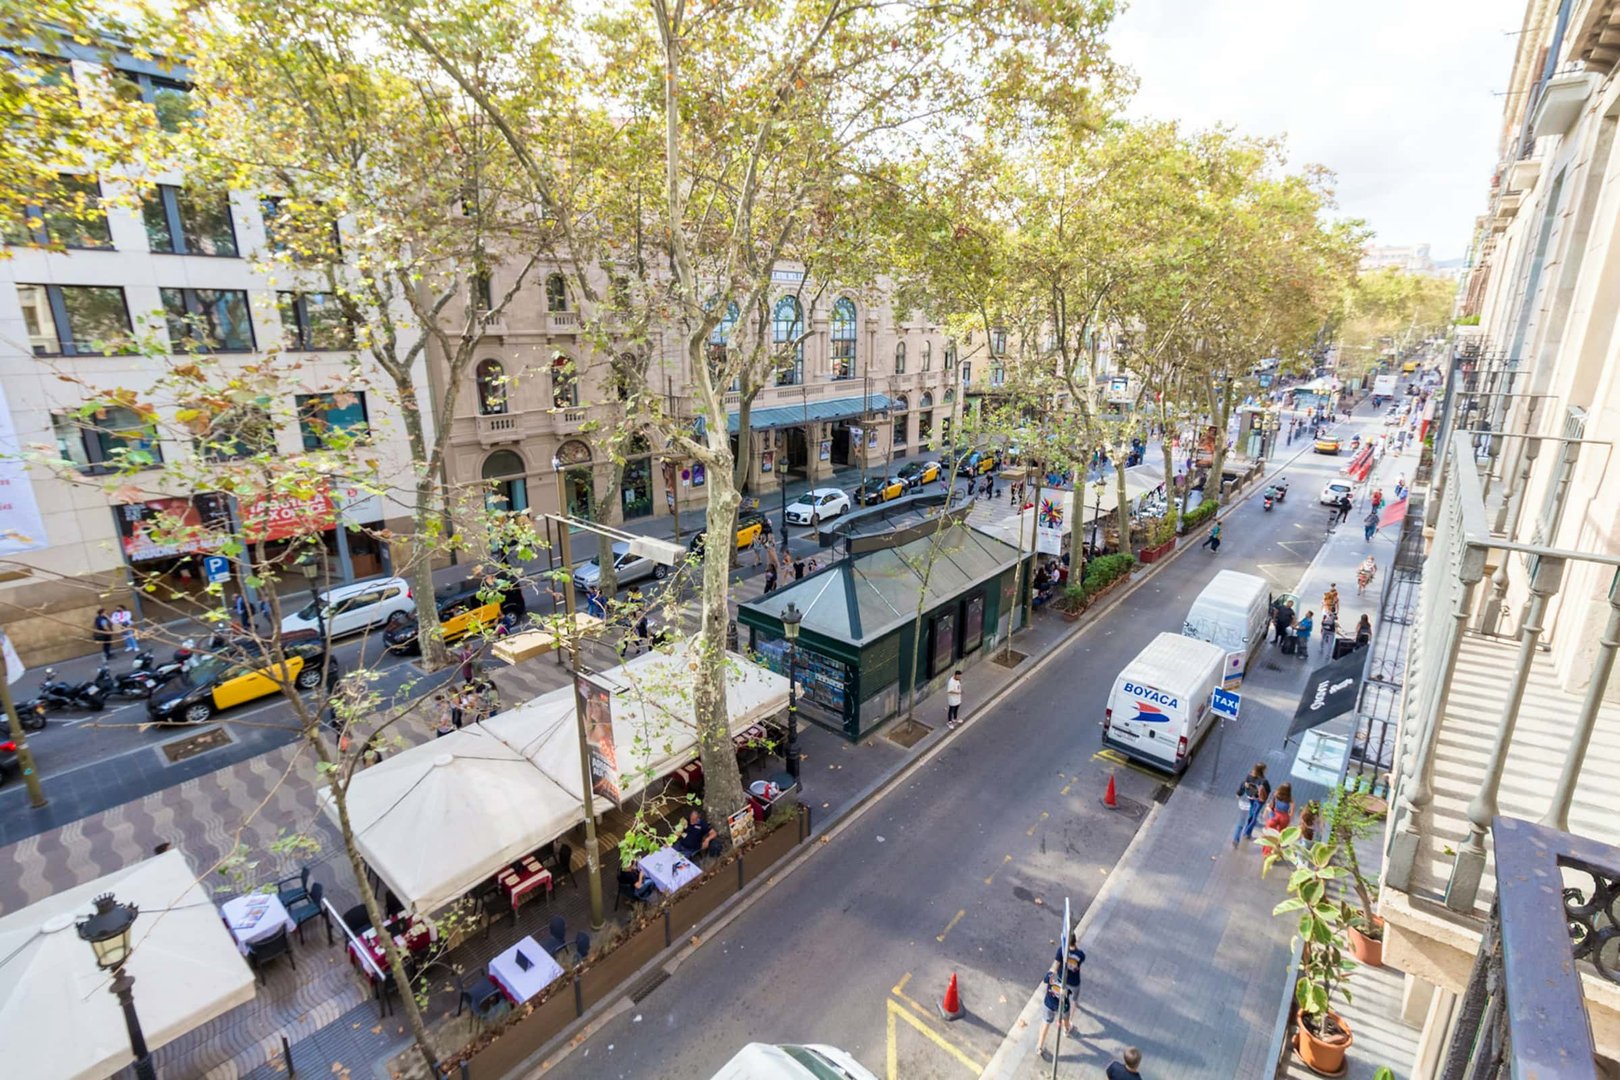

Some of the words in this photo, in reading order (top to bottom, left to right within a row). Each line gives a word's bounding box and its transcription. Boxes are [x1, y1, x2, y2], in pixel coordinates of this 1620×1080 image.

[209, 558, 223, 573] P
[1123, 682, 1178, 709] BOYACA
[1214, 695, 1239, 710] TAXI
